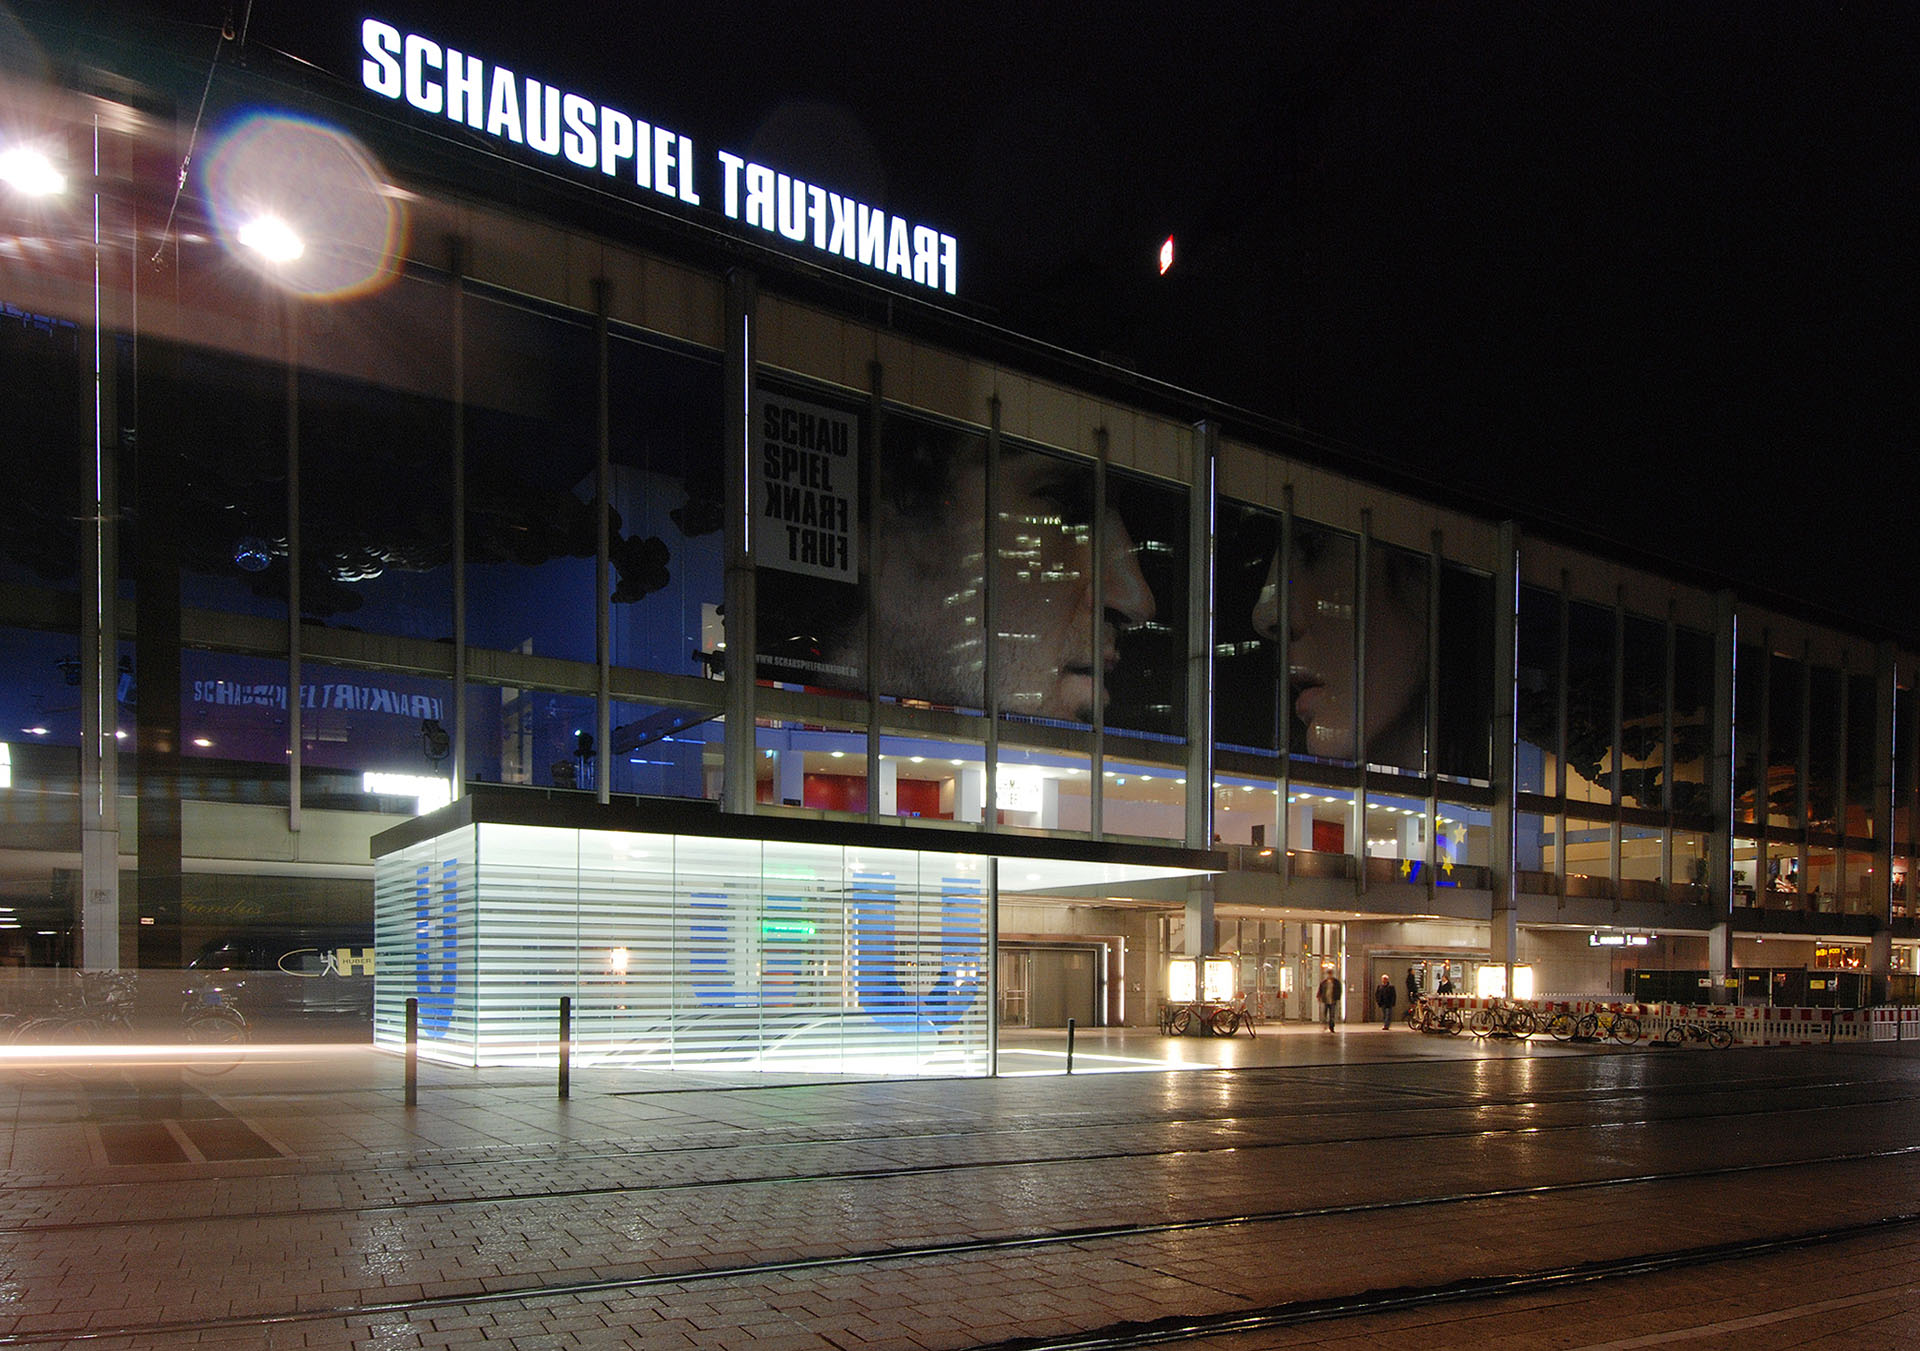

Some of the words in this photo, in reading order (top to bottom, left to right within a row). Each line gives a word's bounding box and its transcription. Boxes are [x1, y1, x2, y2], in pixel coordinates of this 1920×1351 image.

[361, 17, 700, 206] SCHAUSPIEL
[764, 402, 848, 458] SCHAU
[764, 442, 833, 493] SPIEL
[415, 858, 457, 1038] U
[853, 873, 981, 1033] U
